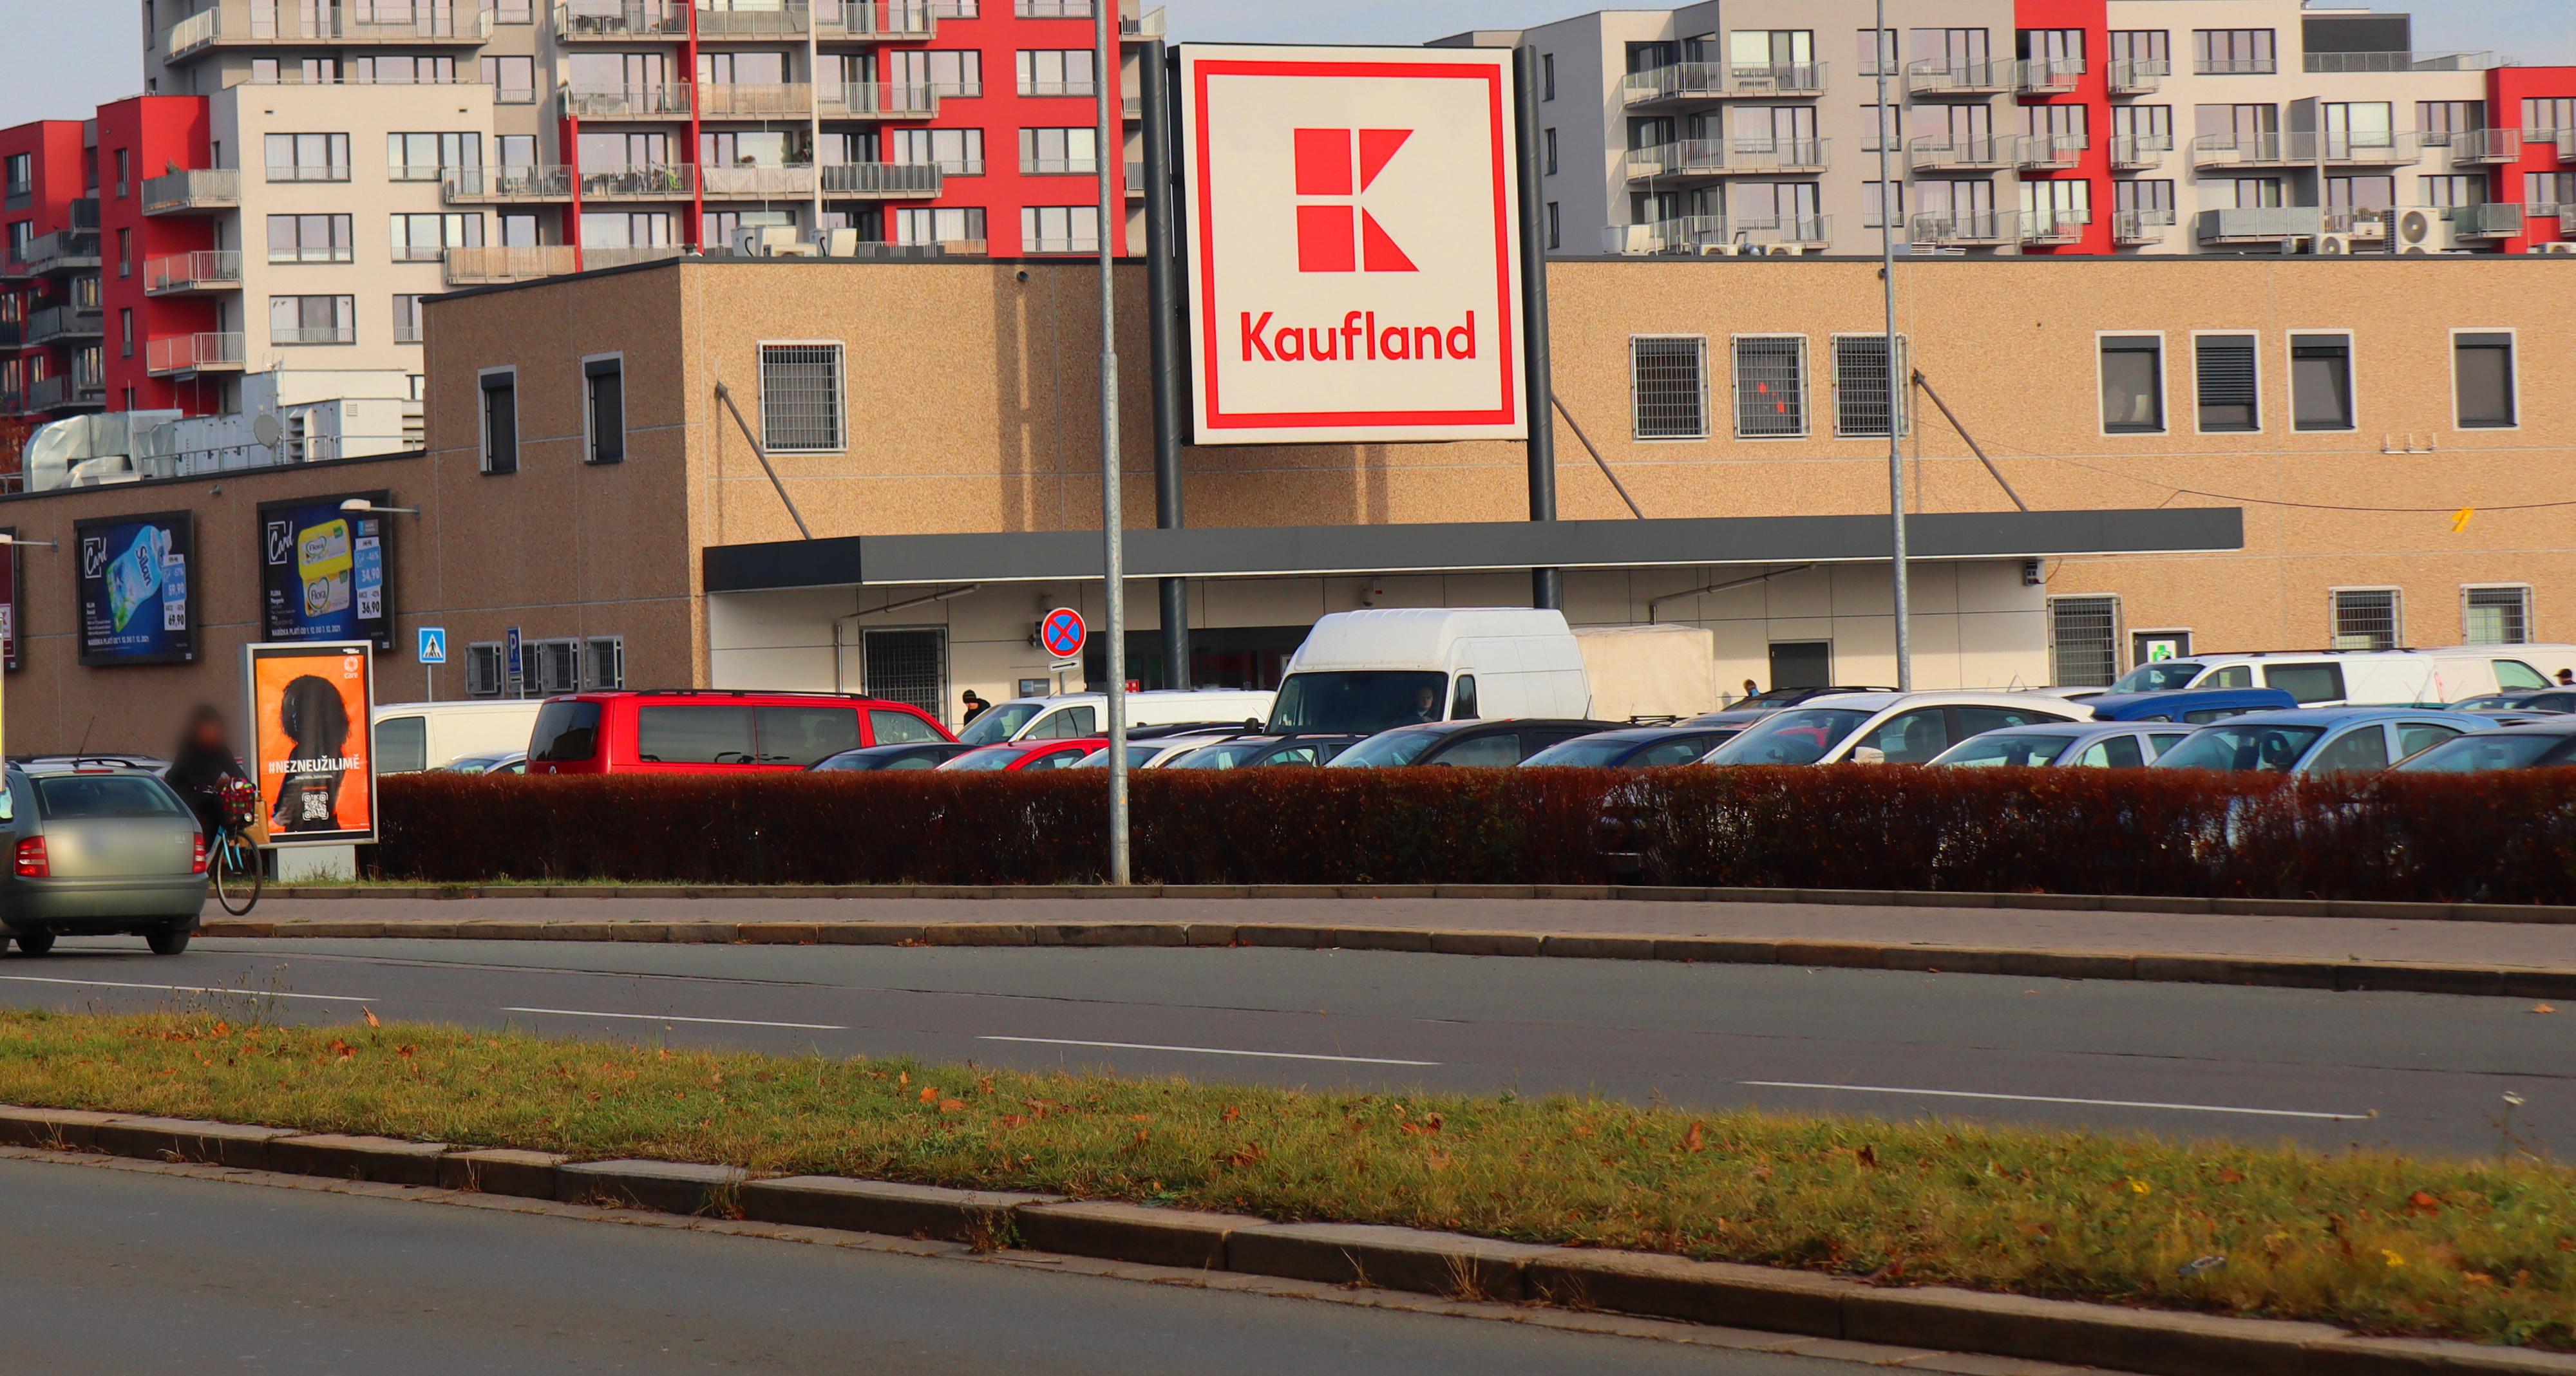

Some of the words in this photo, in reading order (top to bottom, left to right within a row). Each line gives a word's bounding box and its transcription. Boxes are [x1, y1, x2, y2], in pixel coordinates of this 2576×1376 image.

[1294, 128, 1420, 272] K
[1240, 310, 1476, 361] Kaufland
[86, 536, 108, 575] Card
[271, 520, 294, 561] Card
[135, 546, 152, 587] Silan
[311, 590, 326, 601] Flora
[361, 601, 380, 615] 36,90
[168, 614, 184, 627] 69,90
[509, 634, 517, 659] P
[269, 753, 360, 774] #NEZNEUŽILIMĚ
